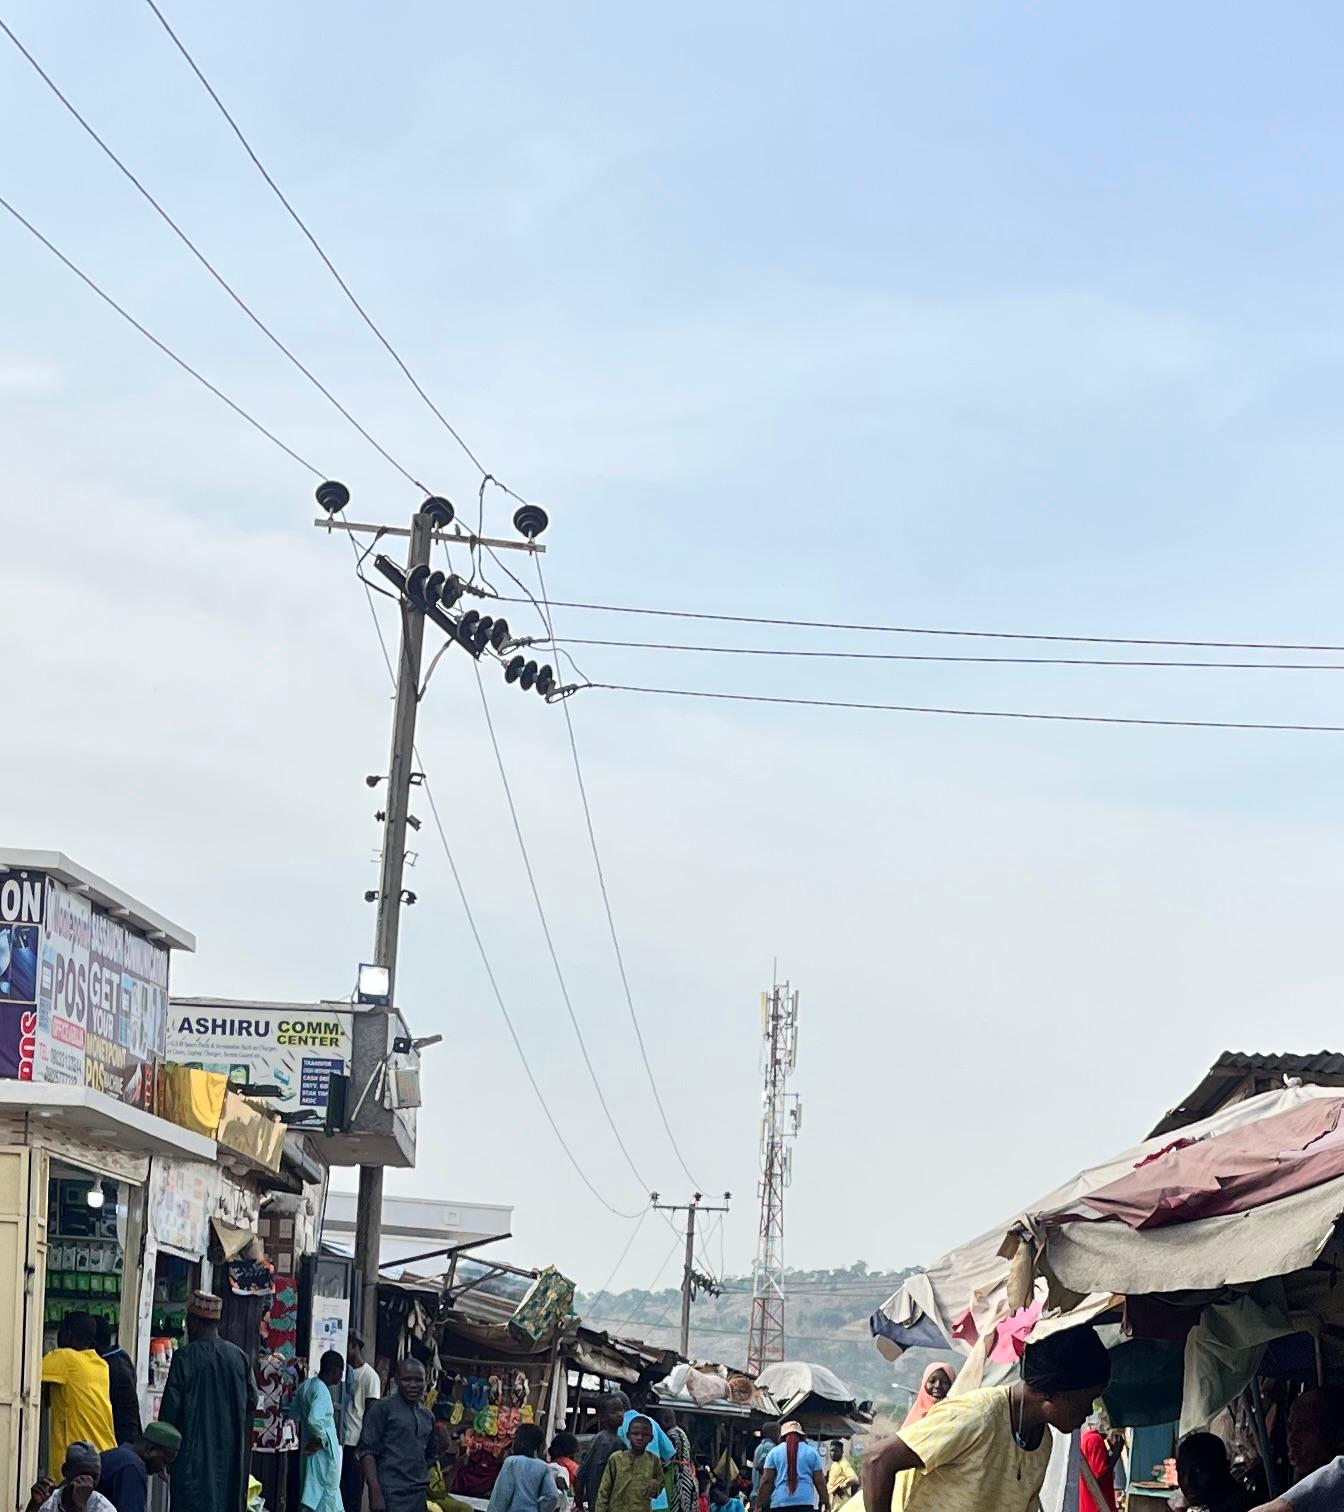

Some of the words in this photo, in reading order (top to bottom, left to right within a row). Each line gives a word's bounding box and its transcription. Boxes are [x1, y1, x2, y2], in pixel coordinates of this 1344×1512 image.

[53, 952, 86, 1022] POS
[88, 961, 121, 1014] GET
[93, 1004, 116, 1040] YOUR
[178, 1017, 270, 1037] ASHIRU
[277, 1020, 346, 1036] COMM.
[277, 1035, 339, 1047] CENTER
[86, 1058, 104, 1092] POS
